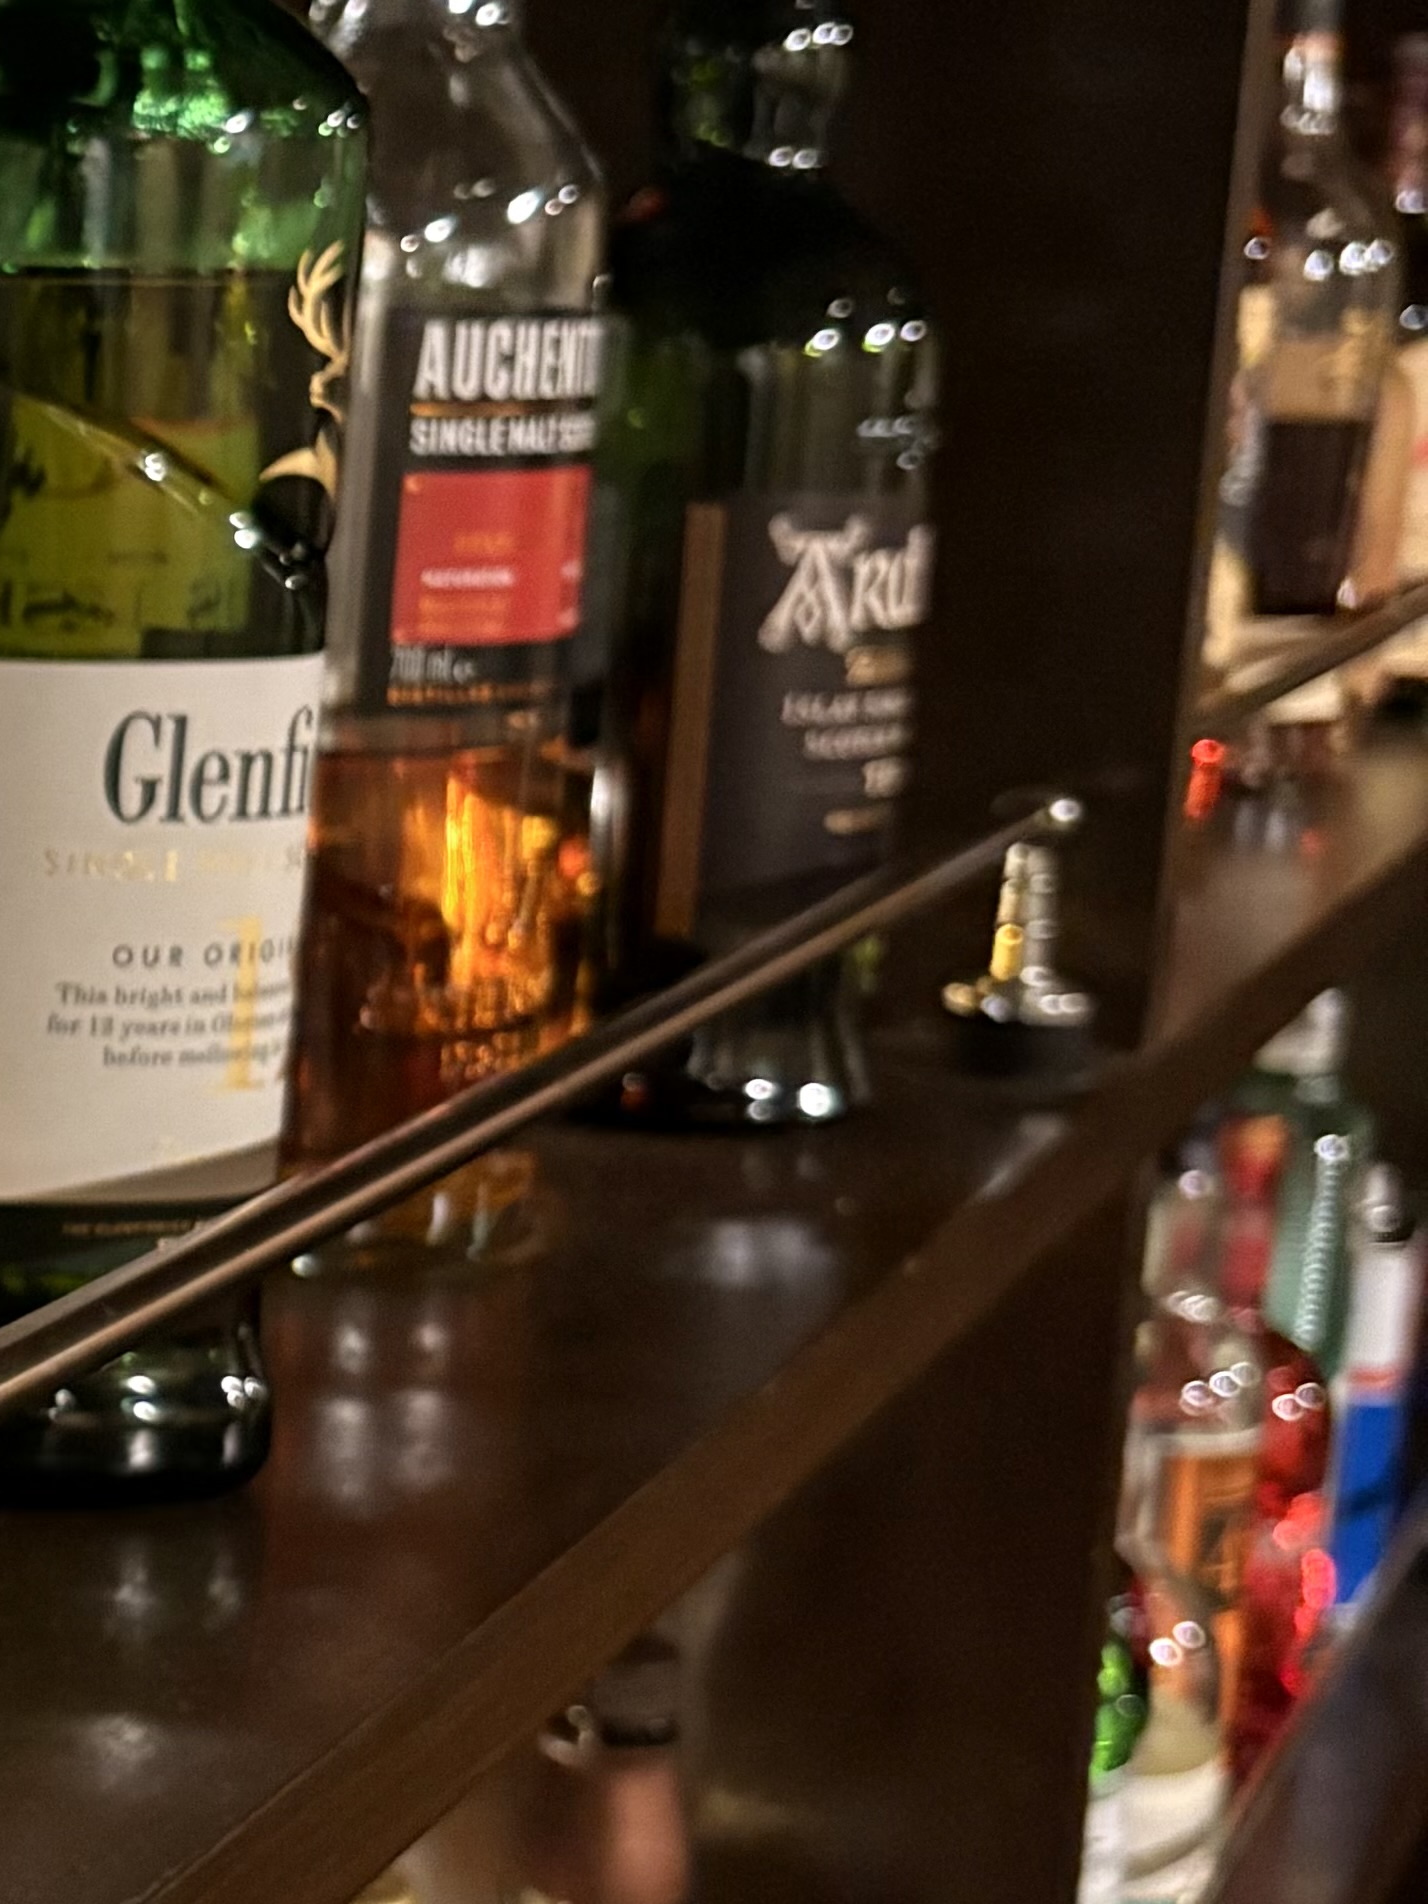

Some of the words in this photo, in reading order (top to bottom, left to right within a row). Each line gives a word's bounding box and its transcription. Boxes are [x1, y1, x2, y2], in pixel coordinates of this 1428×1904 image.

[111, 943, 184, 969] OUR
[55, 980, 108, 1007] This
[114, 982, 182, 1010] bright
[188, 982, 227, 1005] and
[46, 1012, 81, 1037] for
[119, 1018, 181, 1043] years
[102, 1042, 173, 1068] before
